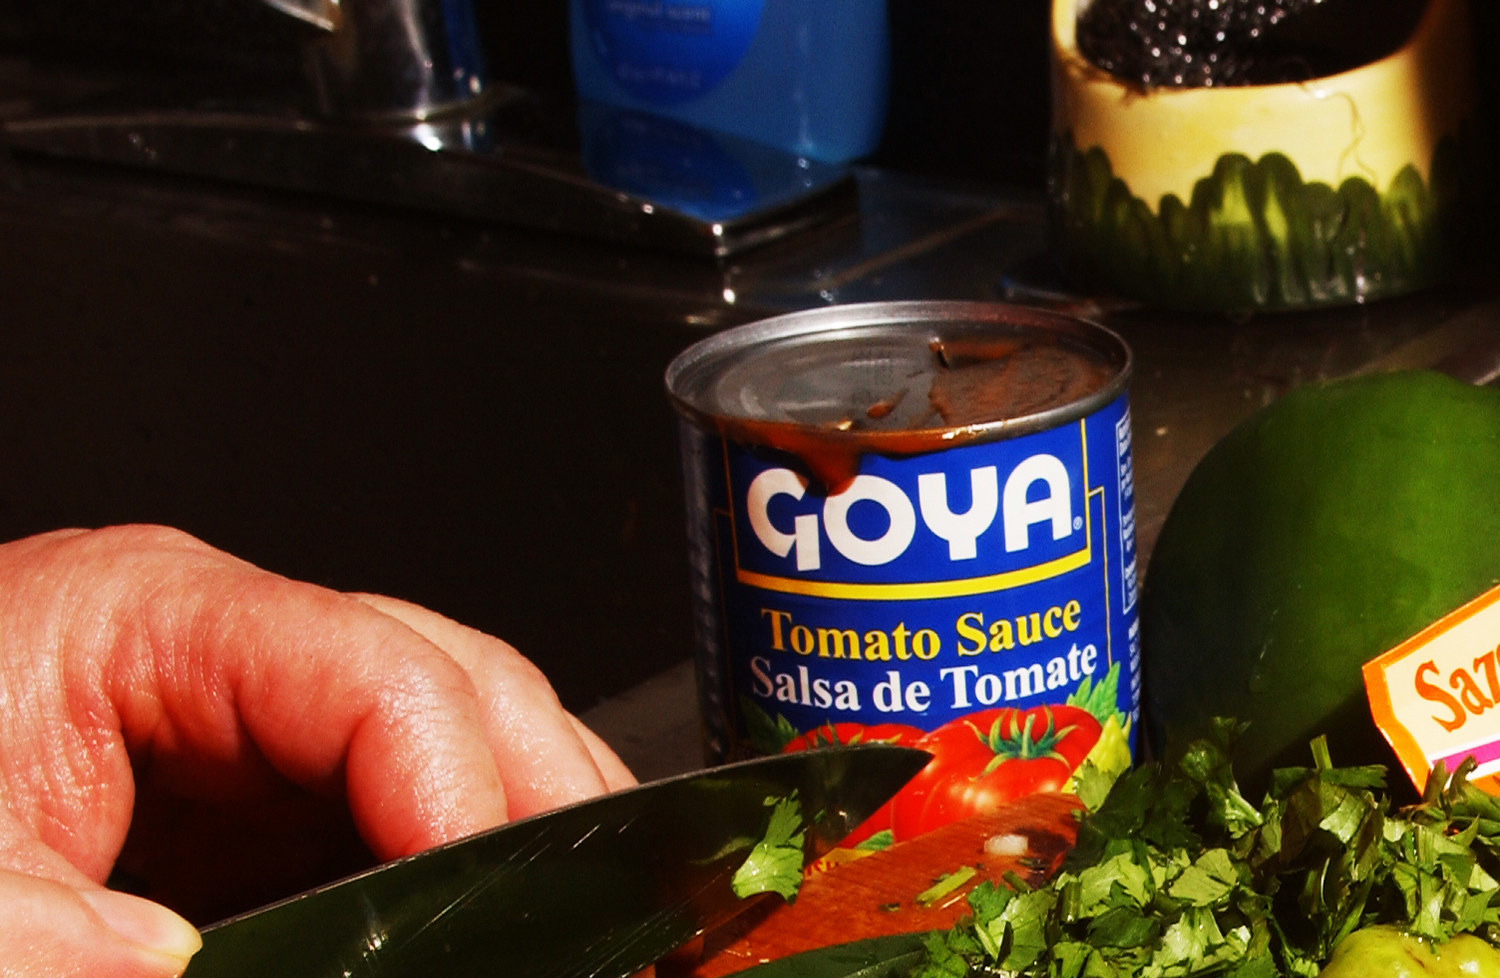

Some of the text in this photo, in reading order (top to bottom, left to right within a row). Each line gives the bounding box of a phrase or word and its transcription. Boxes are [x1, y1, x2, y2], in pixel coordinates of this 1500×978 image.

[747, 454, 1072, 572] GOYA
[761, 598, 1081, 662] Tomato Sauce
[751, 656, 861, 712] Salsa
[872, 672, 930, 713] de
[940, 642, 1098, 709] Tomate
